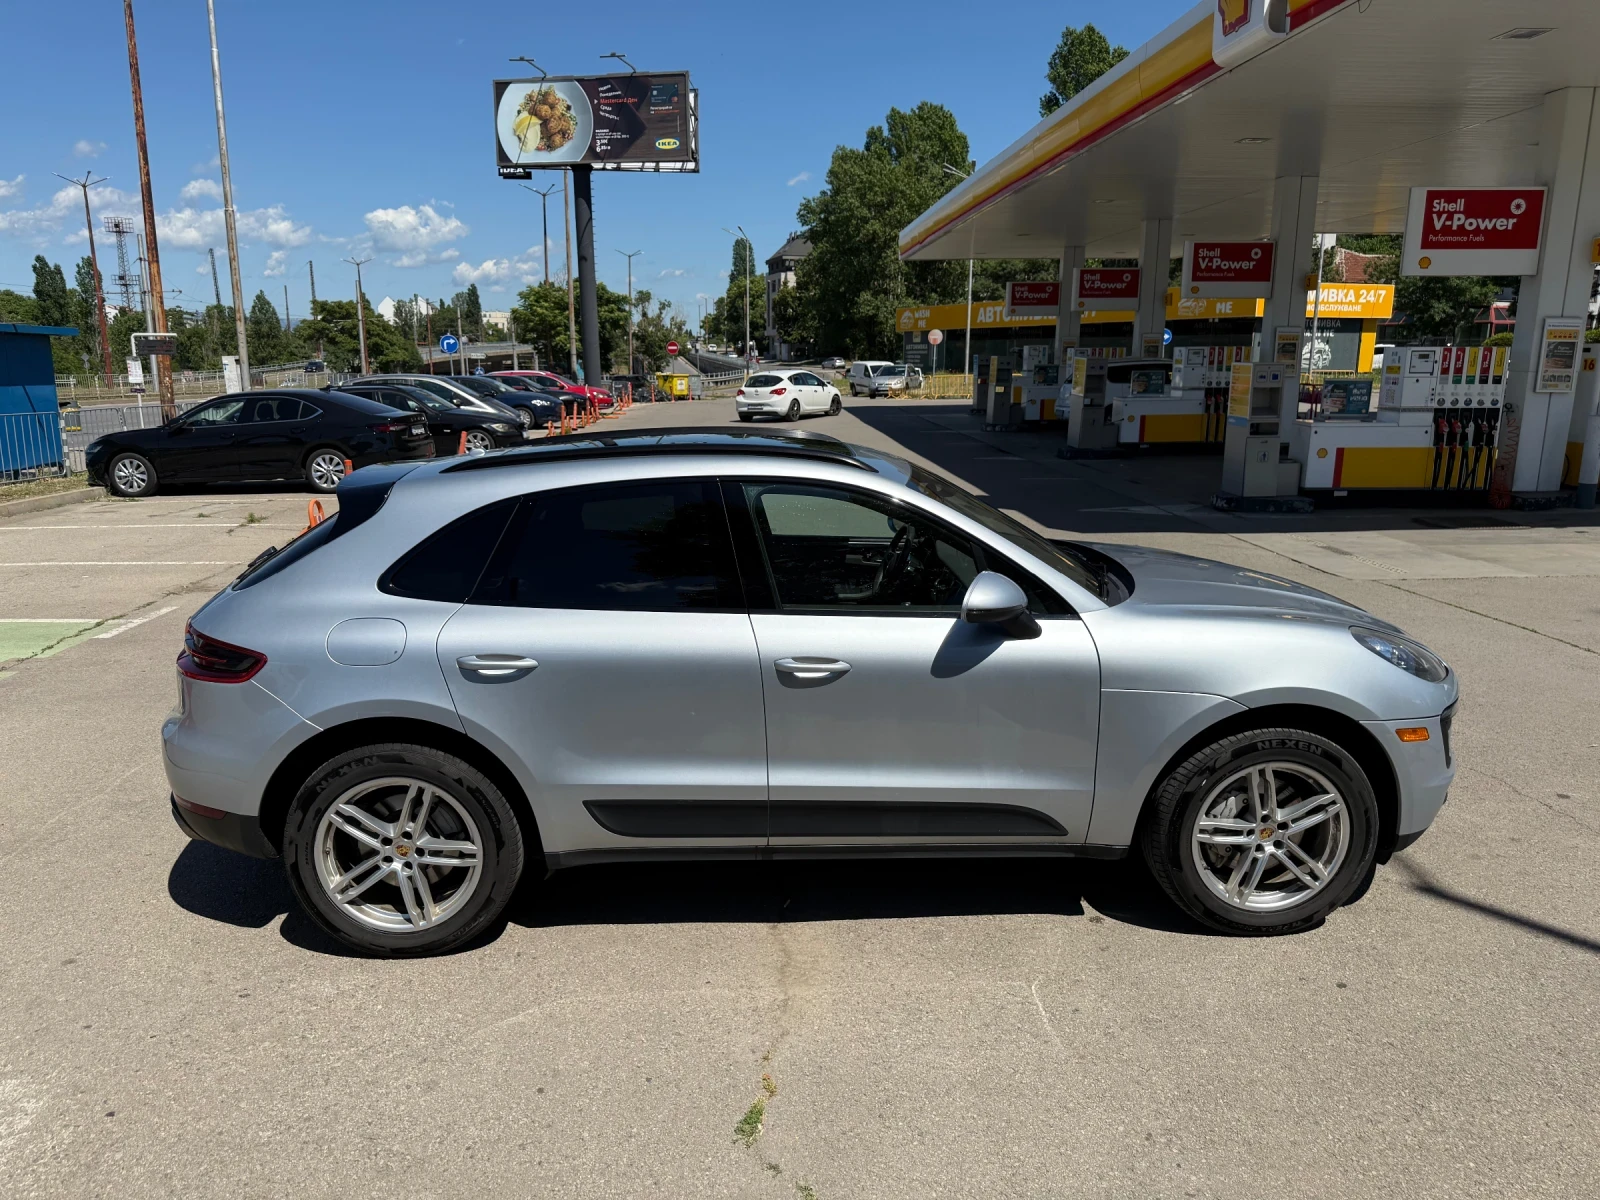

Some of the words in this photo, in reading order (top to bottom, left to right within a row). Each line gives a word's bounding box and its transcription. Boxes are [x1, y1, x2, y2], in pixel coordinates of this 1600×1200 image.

[1432, 199, 1465, 212] Shell
[1432, 213, 1517, 231] V-Power
[1428, 234, 1468, 242] Performance
[1469, 234, 1485, 242] Fuels
[1198, 248, 1220, 257] Shell
[1198, 258, 1256, 270] V-Power
[1083, 273, 1100, 281] Shell
[1083, 281, 1127, 290] V-Power
[1015, 291, 1050, 299] V-Power
[1307, 288, 1356, 303] МИВКА
[1358, 290, 1387, 303] 24/7
[1215, 301, 1233, 313] ME
[915, 309, 930, 318] WASH
[918, 319, 926, 328] ME
[1583, 359, 1595, 371] 16
[1257, 739, 1323, 756] NEXEN
